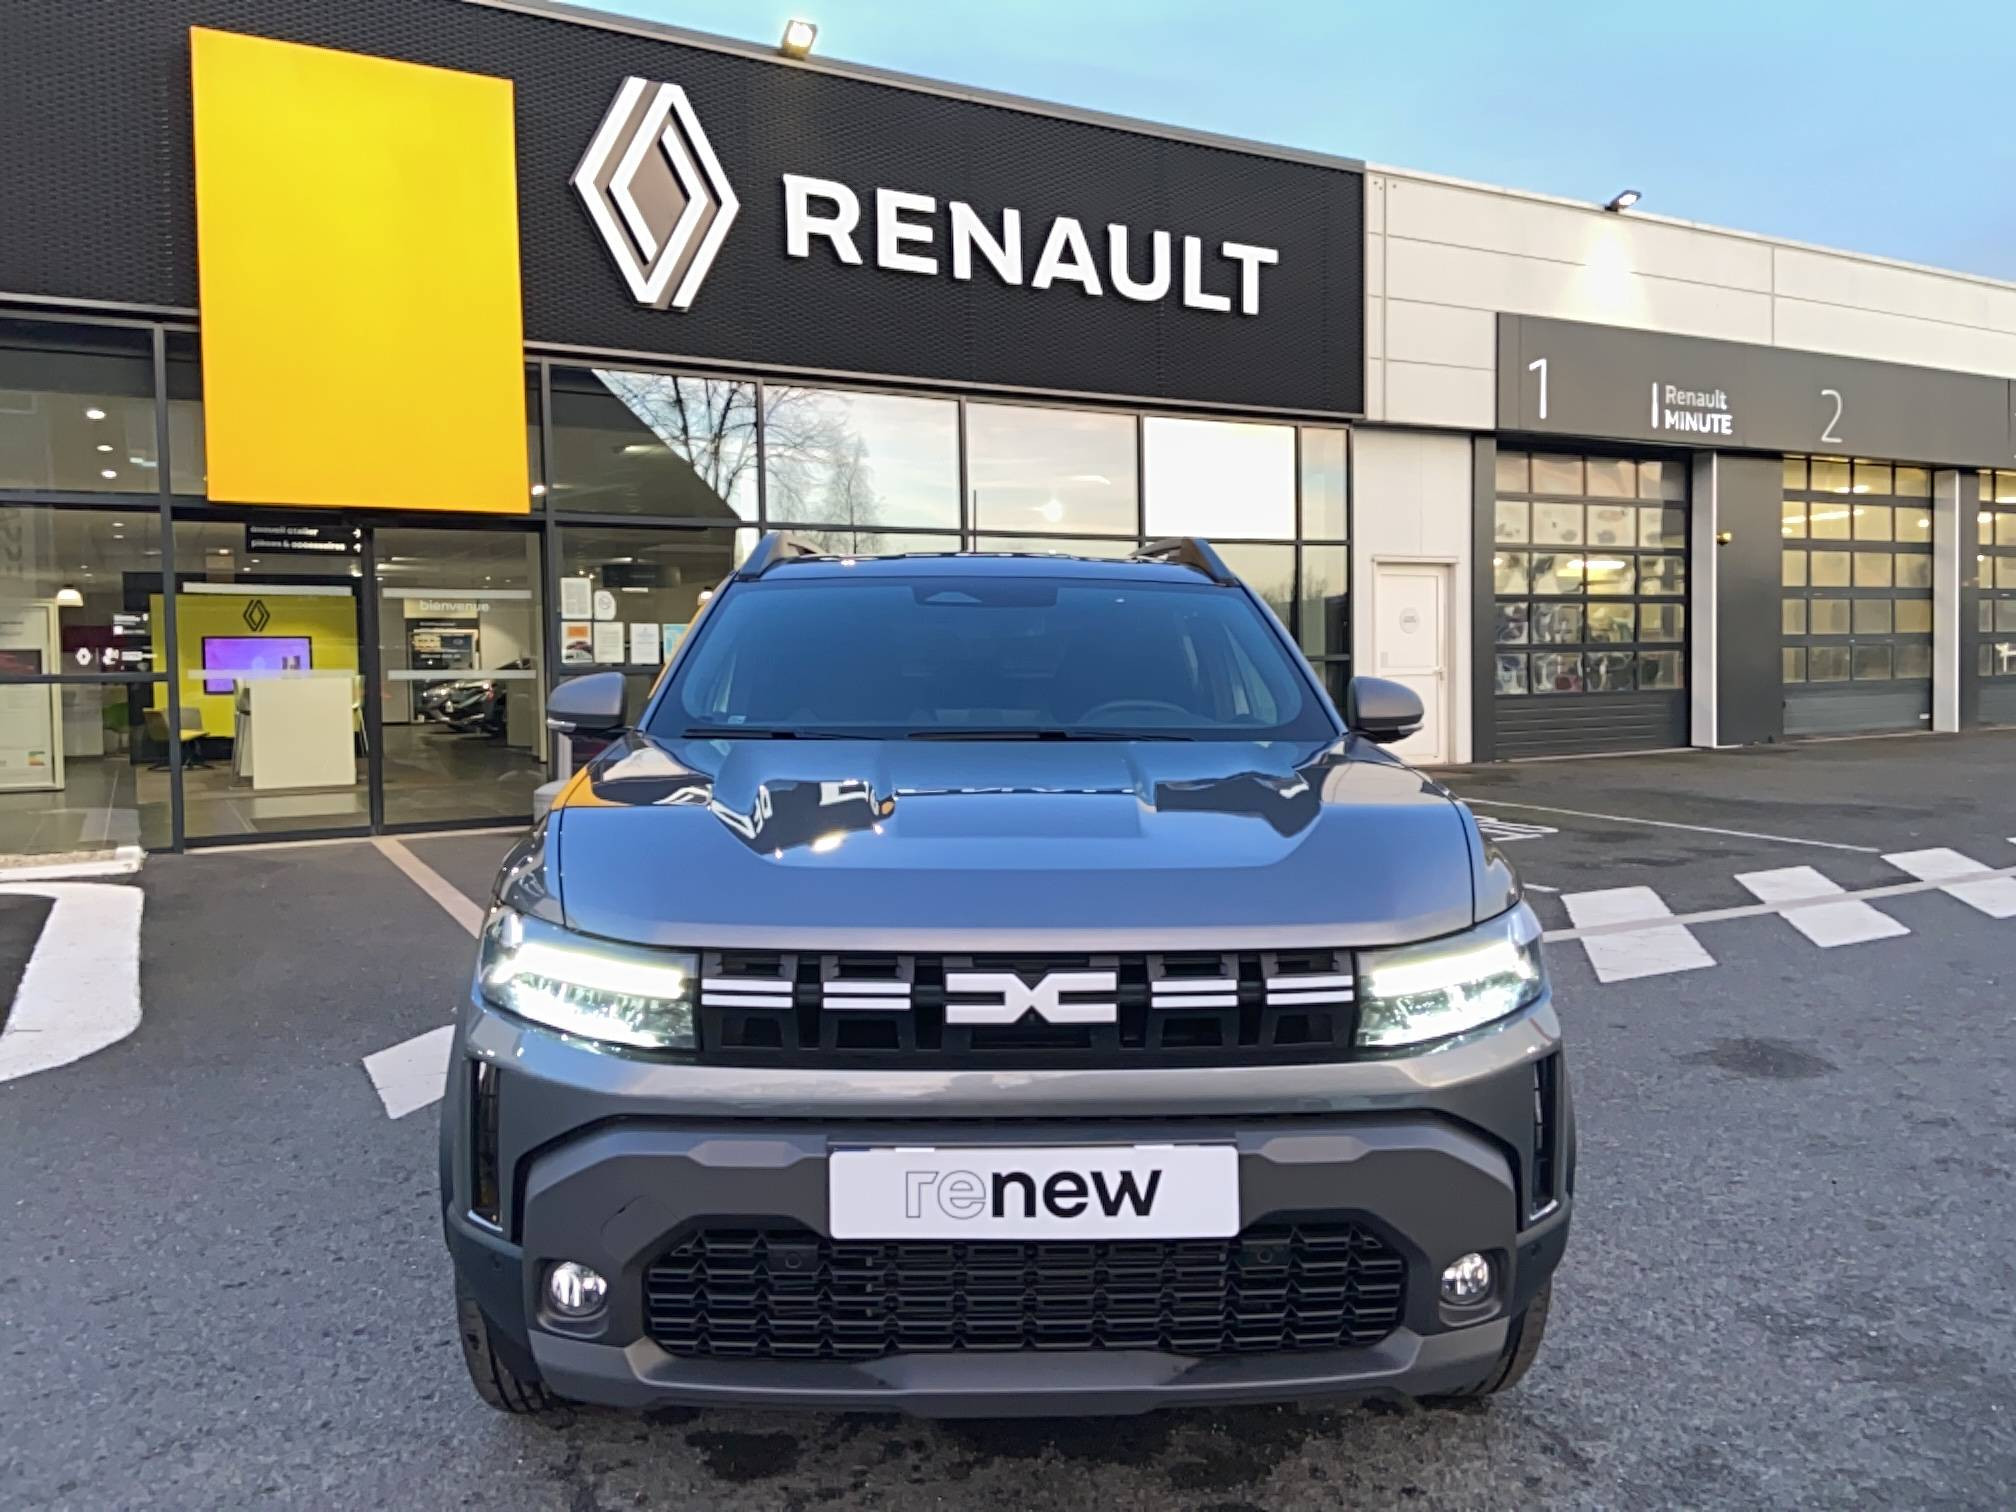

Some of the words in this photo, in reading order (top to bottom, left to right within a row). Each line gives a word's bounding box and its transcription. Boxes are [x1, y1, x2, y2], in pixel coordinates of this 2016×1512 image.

[783, 173, 1280, 315] RENAULT
[1528, 358, 1547, 420] 1
[1665, 384, 1728, 410] Renault
[1664, 408, 1733, 435] MINUTE
[1820, 389, 1844, 443] 2
[420, 599, 489, 613] bienvenue
[905, 1169, 1163, 1219] renew
